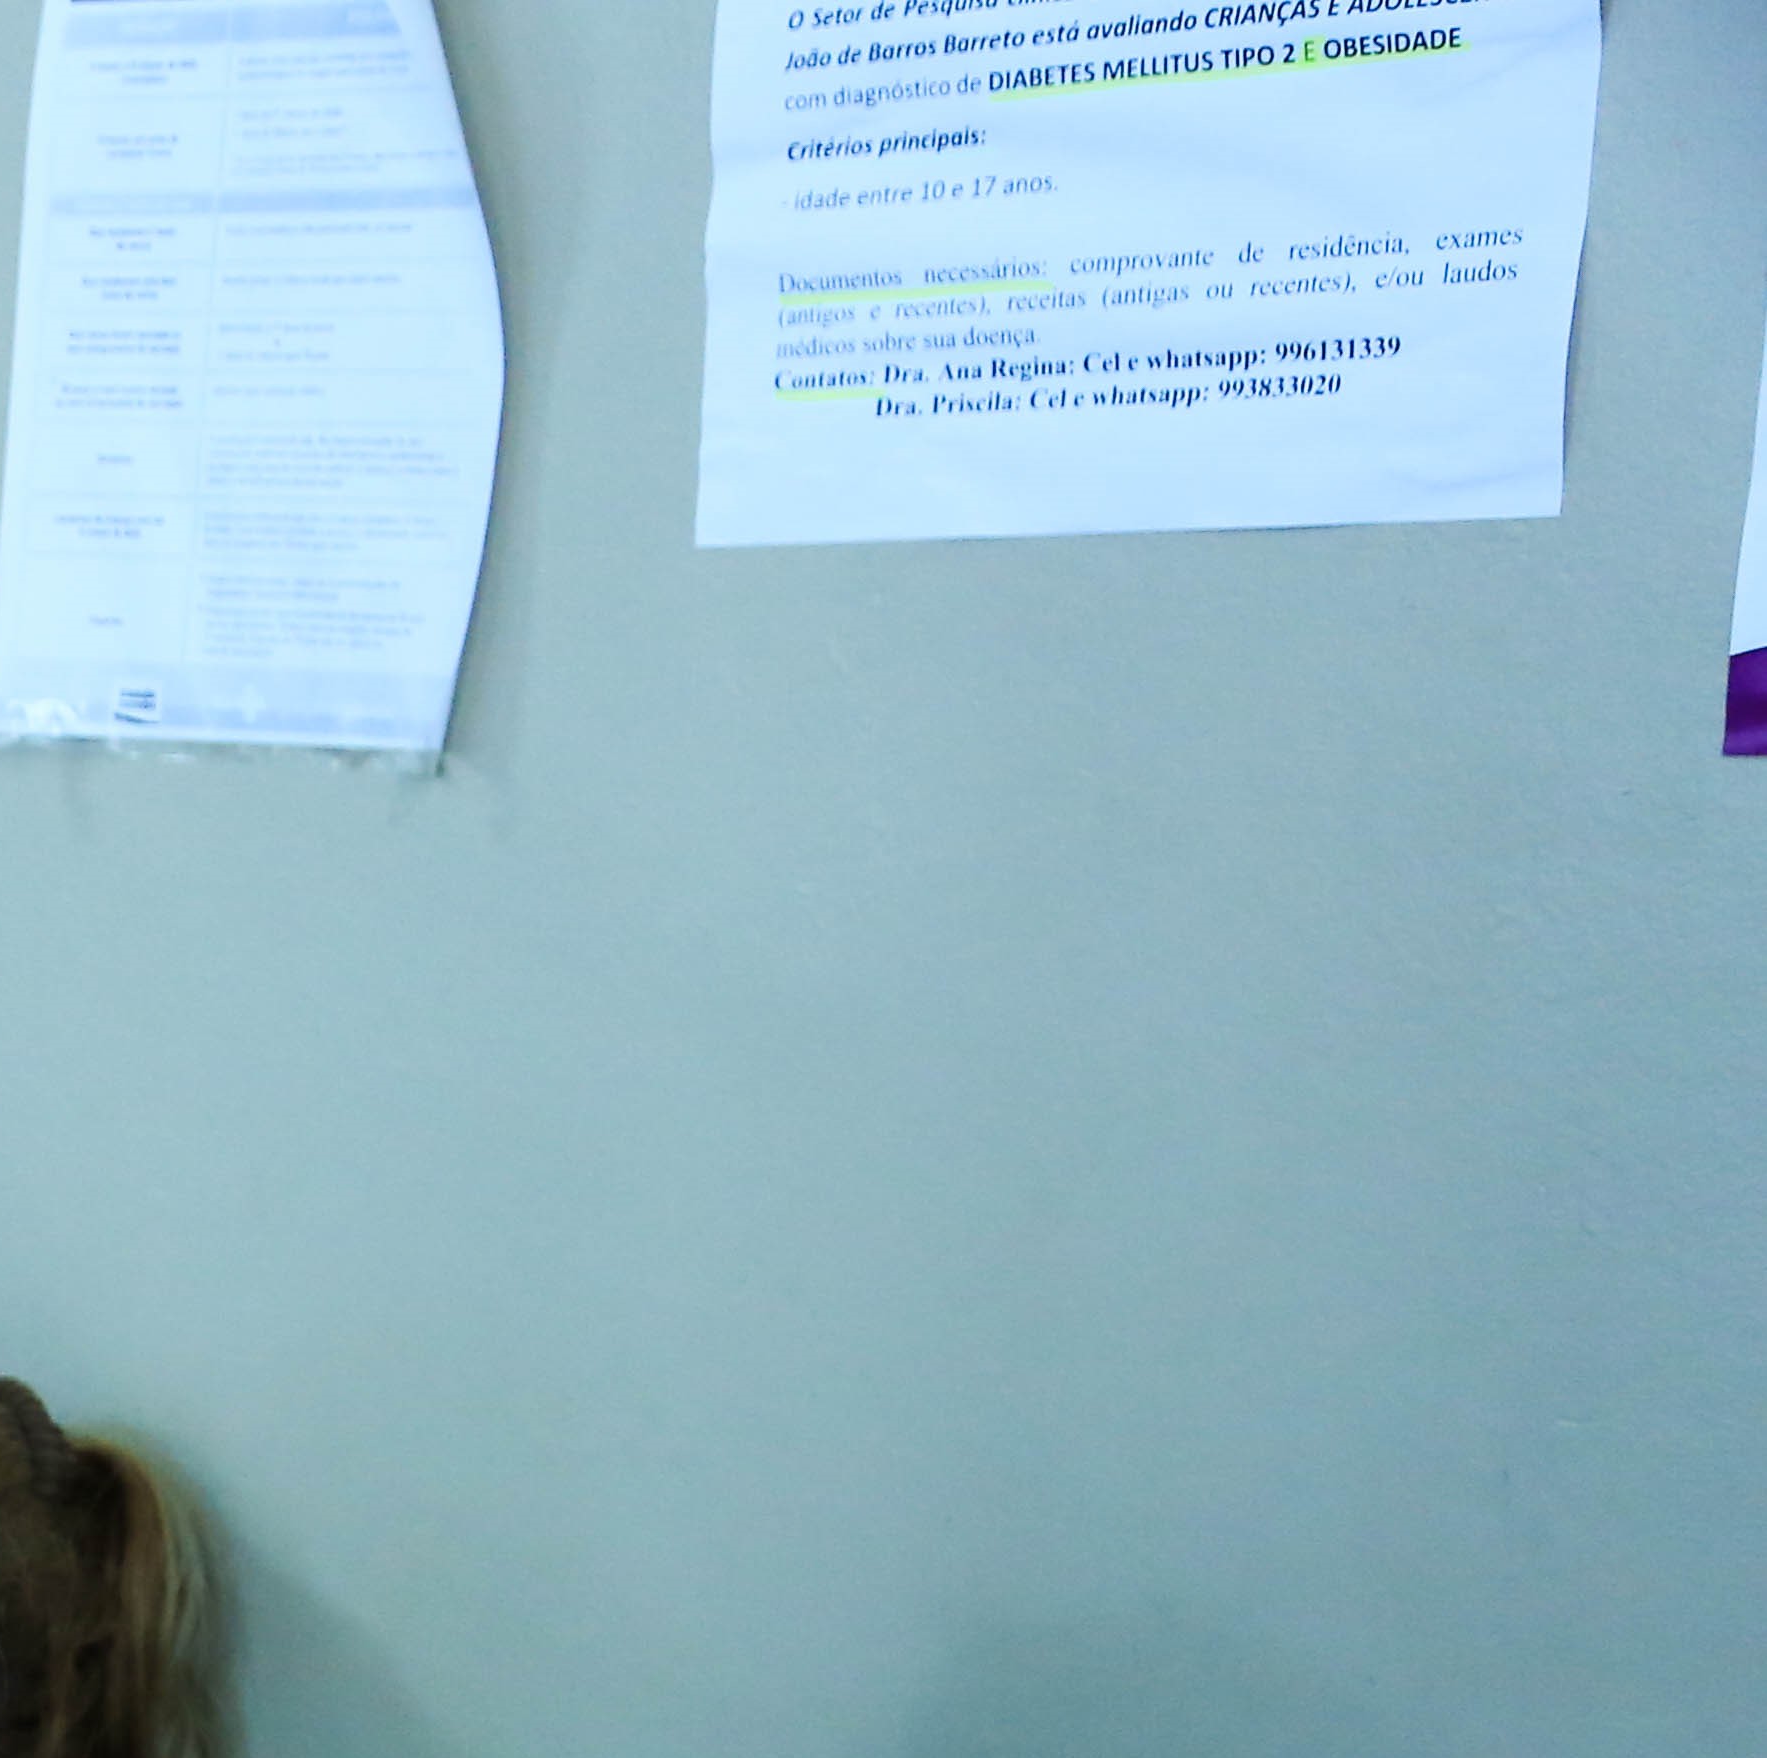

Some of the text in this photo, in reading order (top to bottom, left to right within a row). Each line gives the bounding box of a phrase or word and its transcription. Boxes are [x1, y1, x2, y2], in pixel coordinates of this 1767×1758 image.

[785, 50, 831, 72] João
[838, 43, 861, 65] de
[868, 39, 936, 62] Barros
[944, 31, 1025, 57] Barreto
[1032, 20, 1079, 44] está
[1087, 10, 1197, 41] avaliando
[1204, 0, 1319, 28] CRIANÇAS
[788, 10, 804, 31] O
[812, 6, 863, 28] Setor
[870, 1, 895, 21] de
[785, 27, 1463, 111] com diagnóstico de DIABETES MELLITUS TIPO 2 E OBESIDADE
[788, 127, 987, 161] Critérios principais:
[794, 174, 1059, 211] idade entre 10 e 17 anos.
[778, 225, 1524, 293] Documentos necessários: comprovante de residência, exames
[778, 259, 1518, 329] (antigos e recentes), receitas (antigas ou recentes), e/ou laudos
[774, 335, 1402, 391] Contatos: Dra. Ana Regina: Cel e whatsapp: 996131339
[777, 324, 1041, 358] médicos sobre sua doença.
[875, 373, 1343, 418] Dra. Priscila: Cel e whatsapp: 993833020
